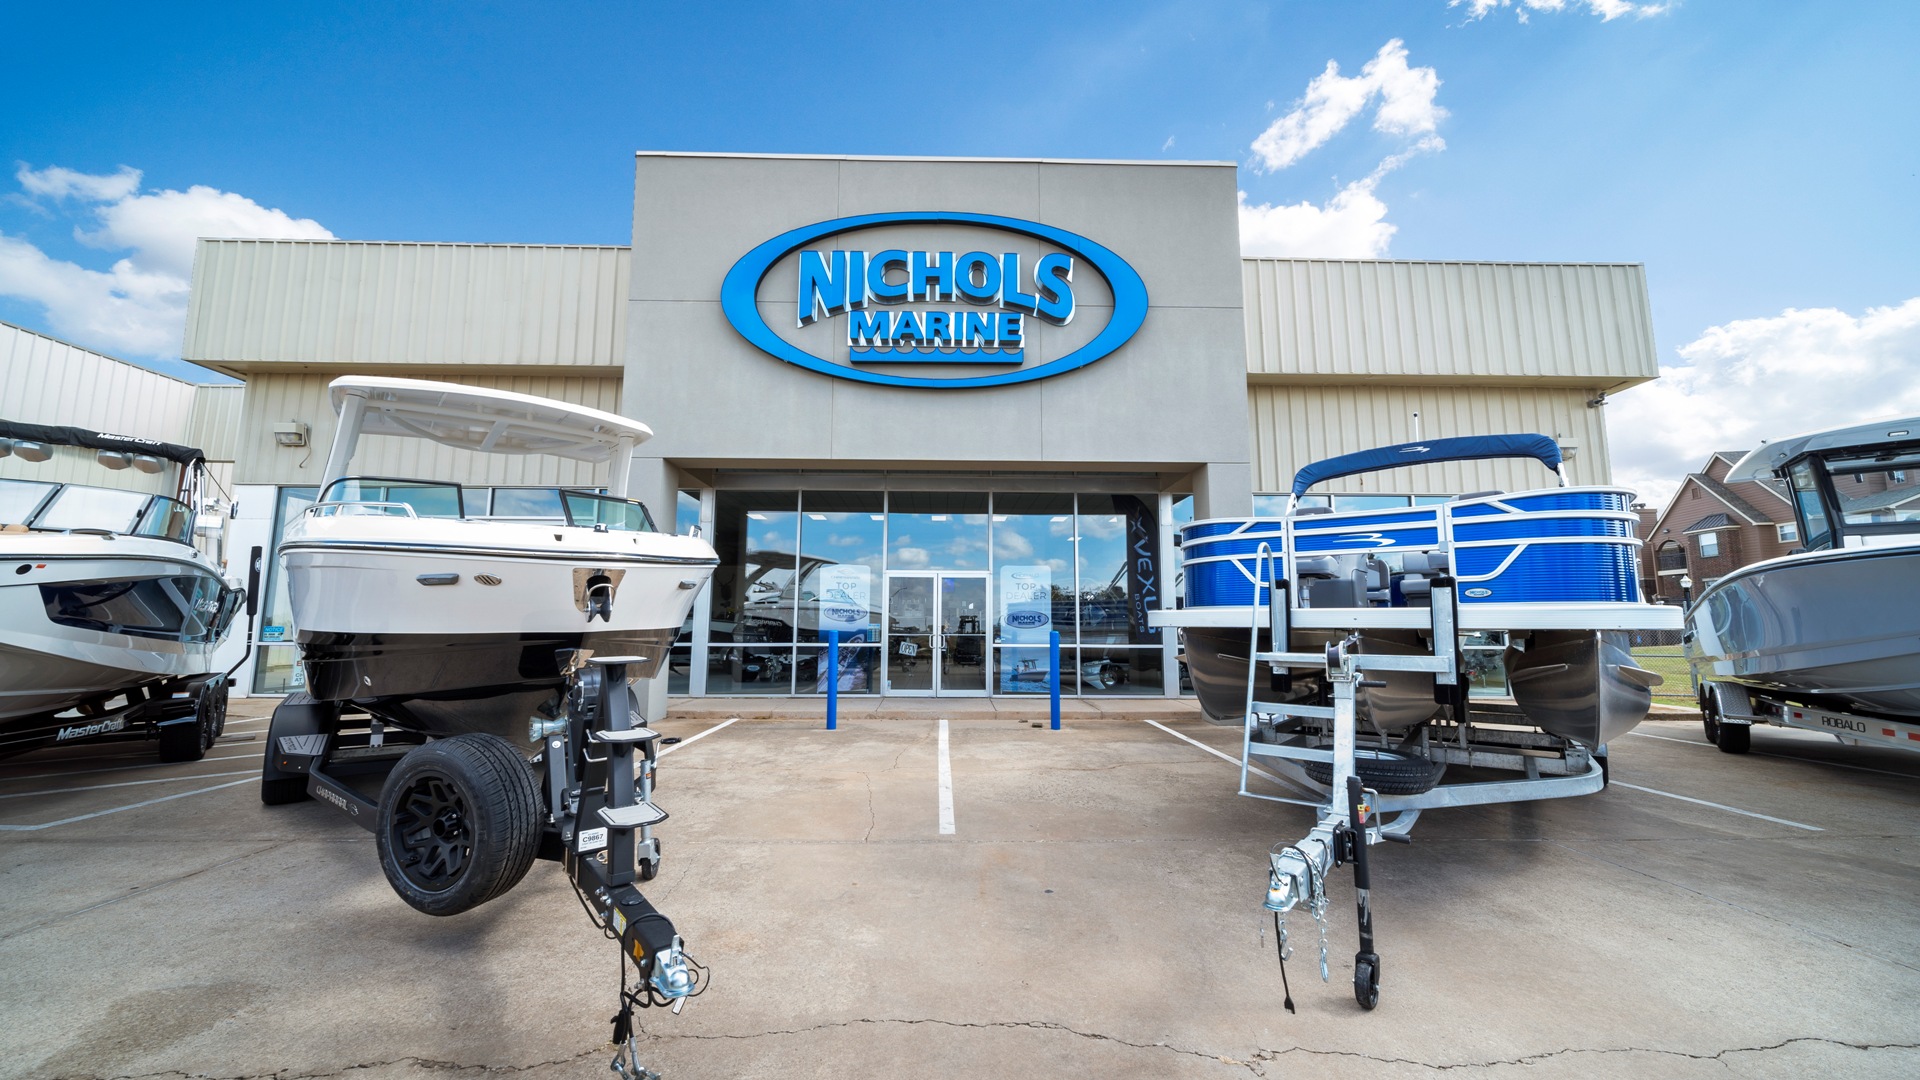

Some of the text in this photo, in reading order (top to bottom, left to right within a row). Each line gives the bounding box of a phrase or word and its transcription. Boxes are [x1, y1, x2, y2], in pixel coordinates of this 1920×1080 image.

[797, 249, 1075, 328] NICHOLS
[847, 311, 1024, 348] MARINE
[97, 432, 162, 446] MasterCraft
[836, 582, 857, 590] TOP
[1006, 591, 1047, 600] DEALER
[831, 608, 861, 616] NICHOLS
[1134, 593, 1145, 633] BOATS
[1012, 615, 1041, 623] NICHOLS
[900, 642, 918, 655] OPEN
[56, 718, 124, 741] MasterCraft
[1821, 715, 1866, 733] ROBALO
[582, 833, 604, 843] C9867
